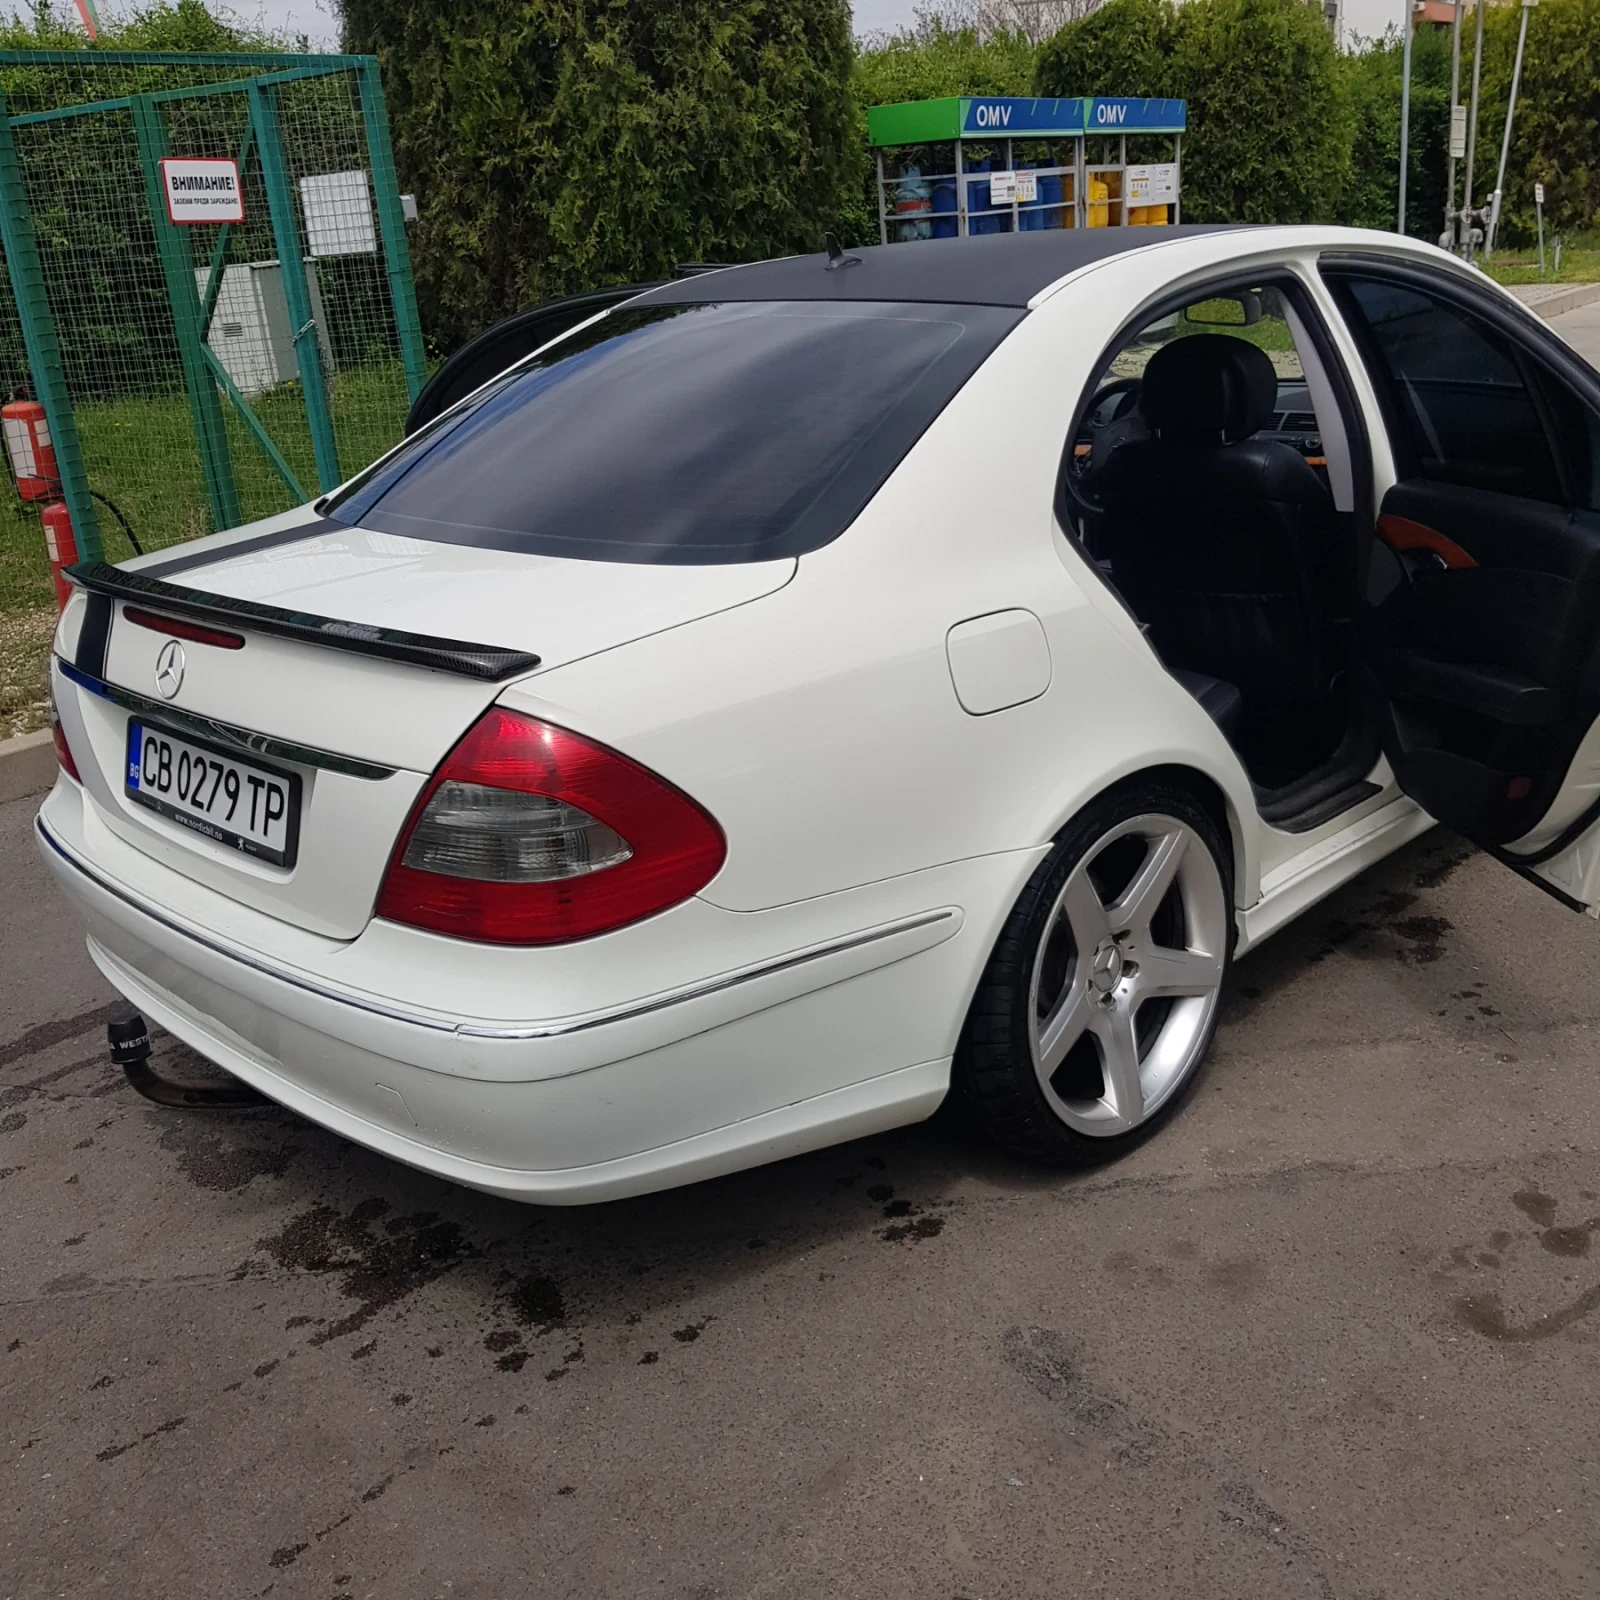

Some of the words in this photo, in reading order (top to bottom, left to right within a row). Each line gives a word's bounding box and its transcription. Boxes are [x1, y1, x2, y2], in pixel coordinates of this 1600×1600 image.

[976, 104, 1012, 127] OMV
[1097, 104, 1128, 125] OMV
[171, 176, 235, 190] ВНИМАНИЕ!
[130, 762, 139, 779] BG
[143, 736, 173, 794] CB
[177, 750, 241, 822] 0279
[247, 774, 285, 837] TP
[174, 813, 223, 841] www.nordicbil.no
[119, 1035, 149, 1049] WEST
